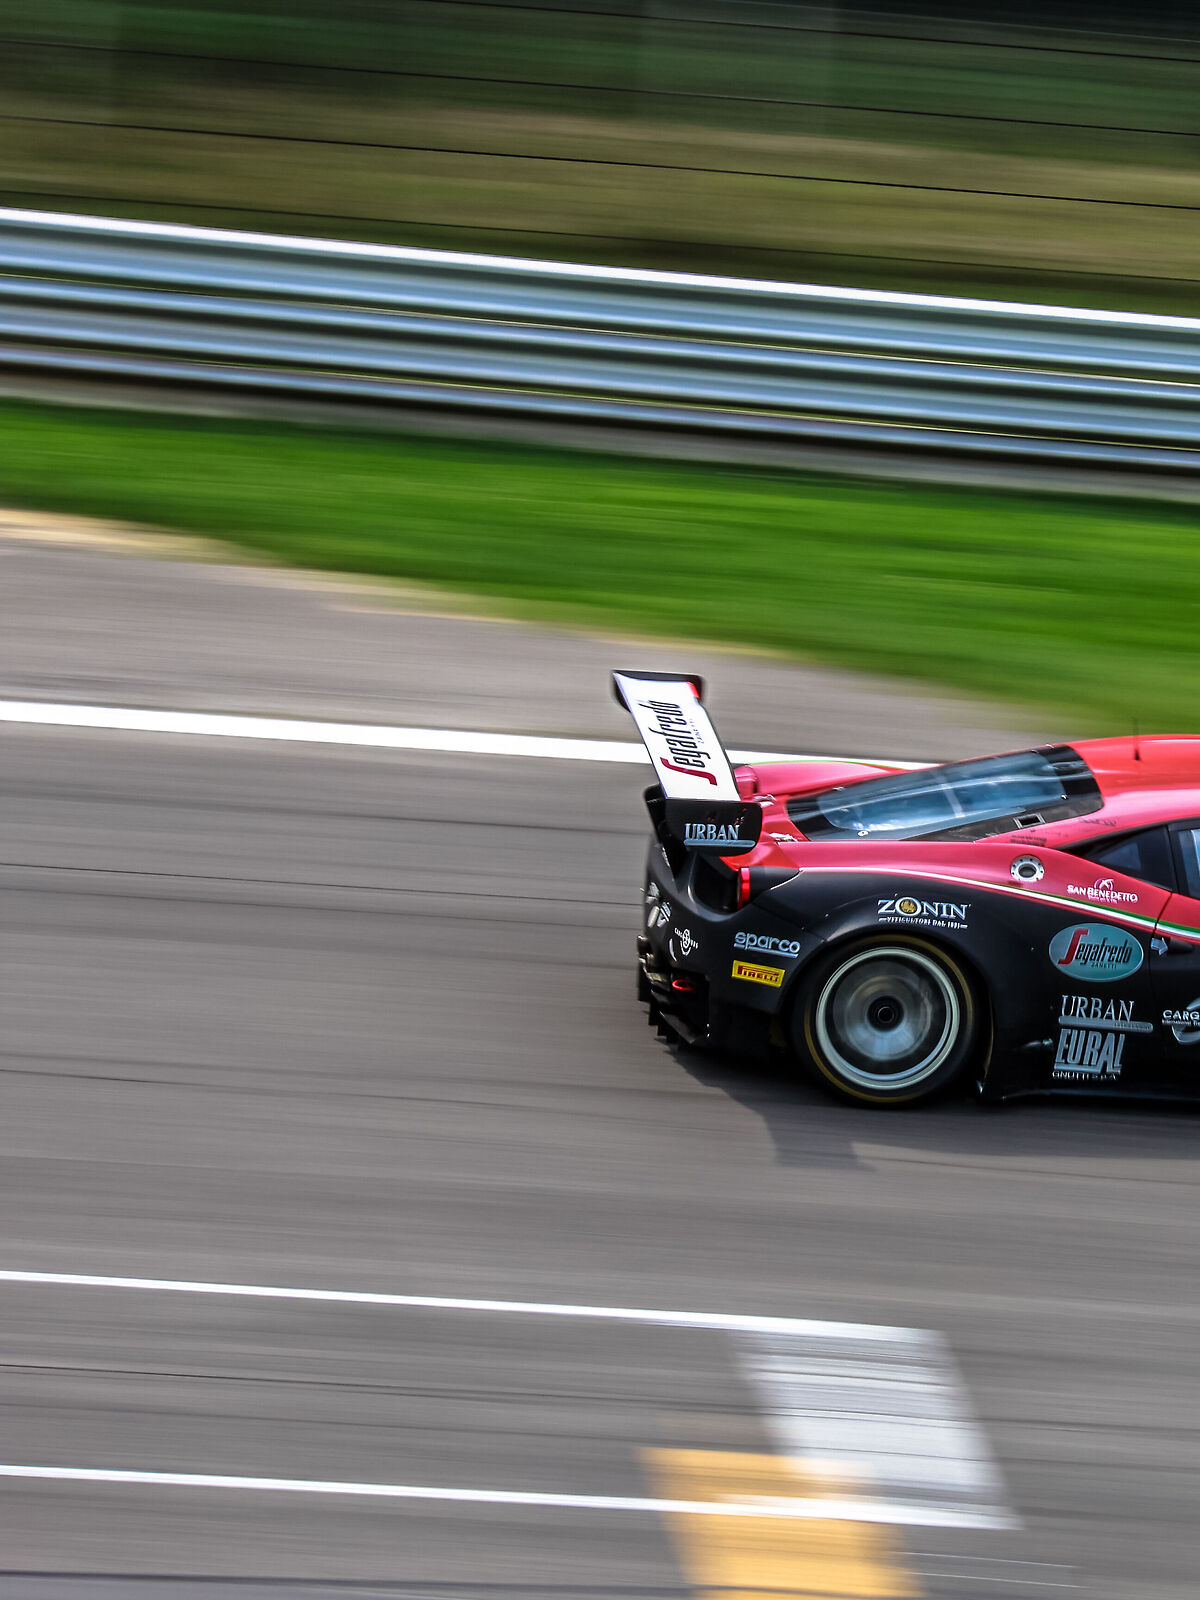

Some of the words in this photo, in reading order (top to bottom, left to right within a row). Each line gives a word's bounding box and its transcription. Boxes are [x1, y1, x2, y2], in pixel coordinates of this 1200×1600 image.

[638, 699, 718, 786] Segafredo
[685, 823, 740, 841] URBAN
[1067, 885, 1086, 896] SAN
[1087, 887, 1139, 903] BENEDETTO
[878, 896, 968, 920] ZONIN
[735, 931, 800, 954] sparco
[1058, 928, 1132, 965] Segafredo
[738, 965, 780, 983] PIRELLI
[1061, 994, 1135, 1023] URBAN
[1055, 1029, 1125, 1073] EURAL
